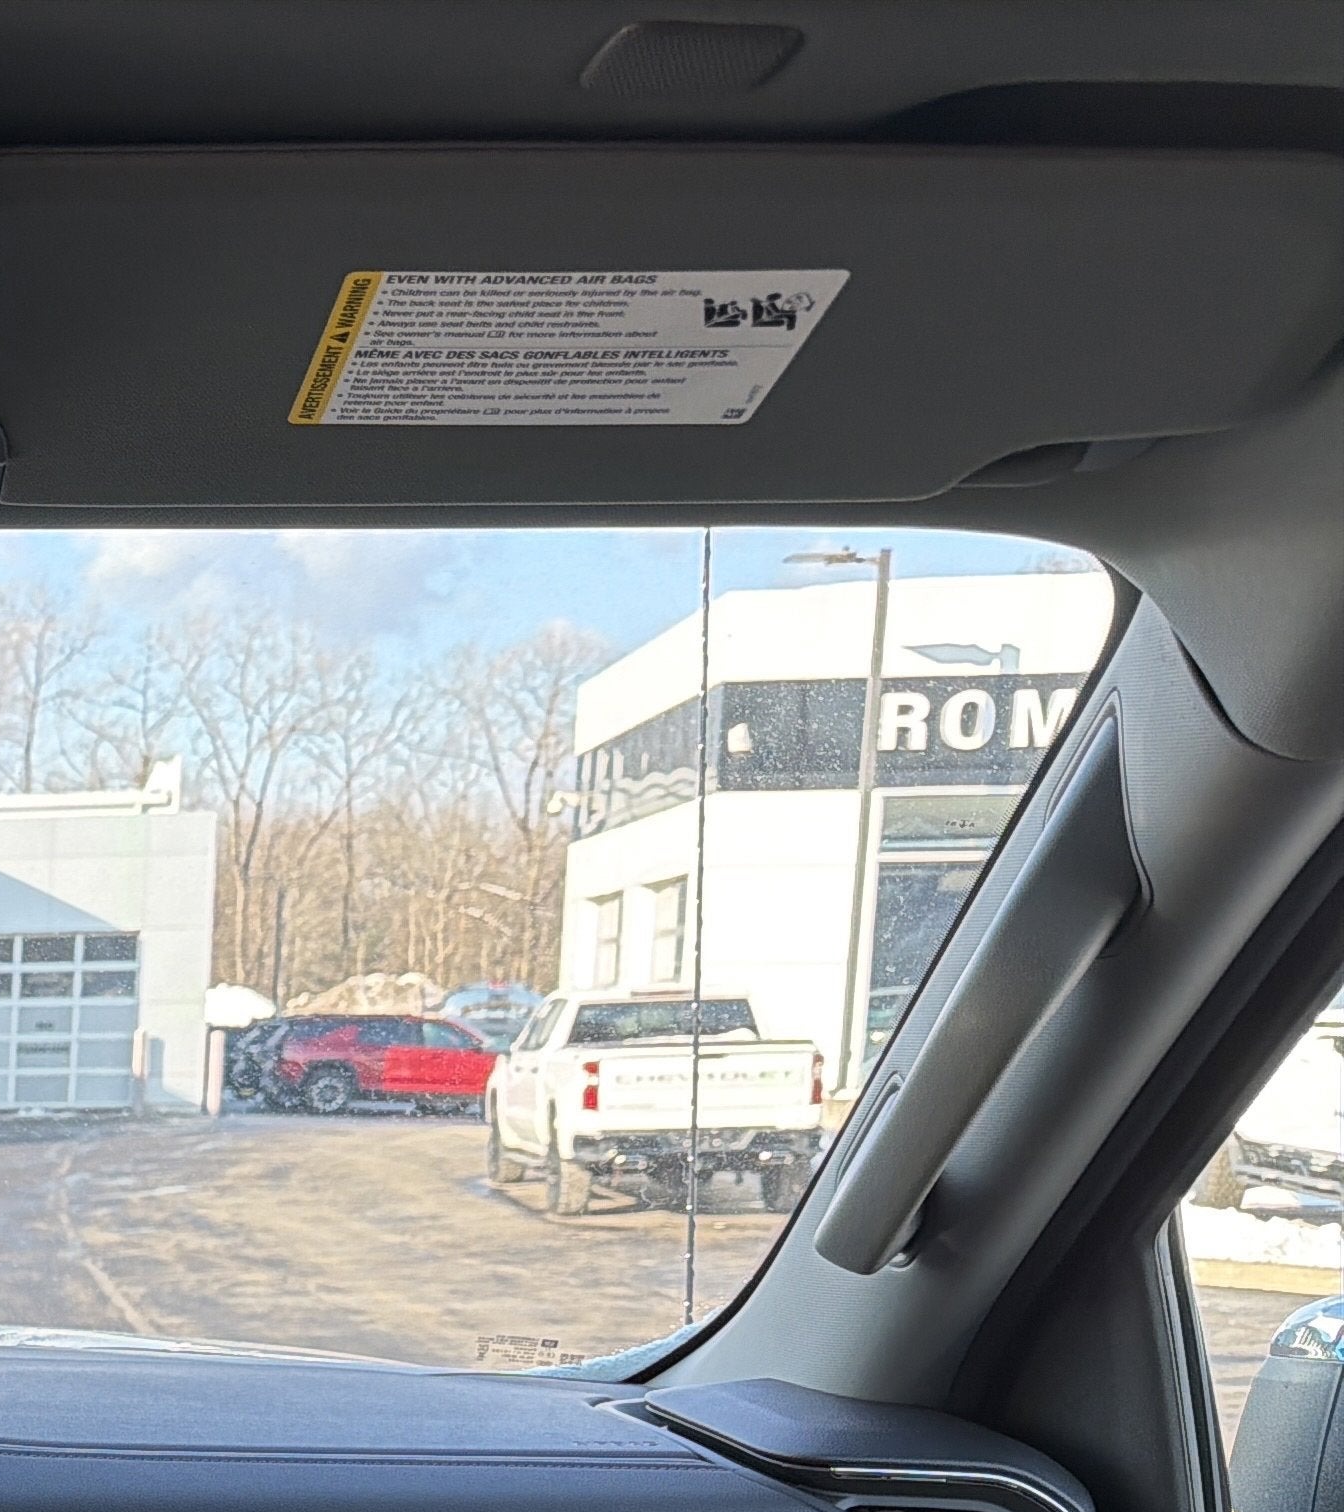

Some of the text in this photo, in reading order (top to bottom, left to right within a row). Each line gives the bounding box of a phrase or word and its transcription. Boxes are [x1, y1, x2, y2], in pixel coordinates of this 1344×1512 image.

[386, 275, 658, 285] EVEN WITH ADVANCED AIR BAGS
[335, 278, 372, 328] WARNING
[403, 350, 443, 360] AVEC
[445, 350, 477, 360] DES
[479, 350, 519, 360] SACS
[522, 350, 620, 360] GONFLABLES
[623, 350, 728, 359] INTELLIGENTS
[298, 345, 344, 420] AVERTISSEMENT
